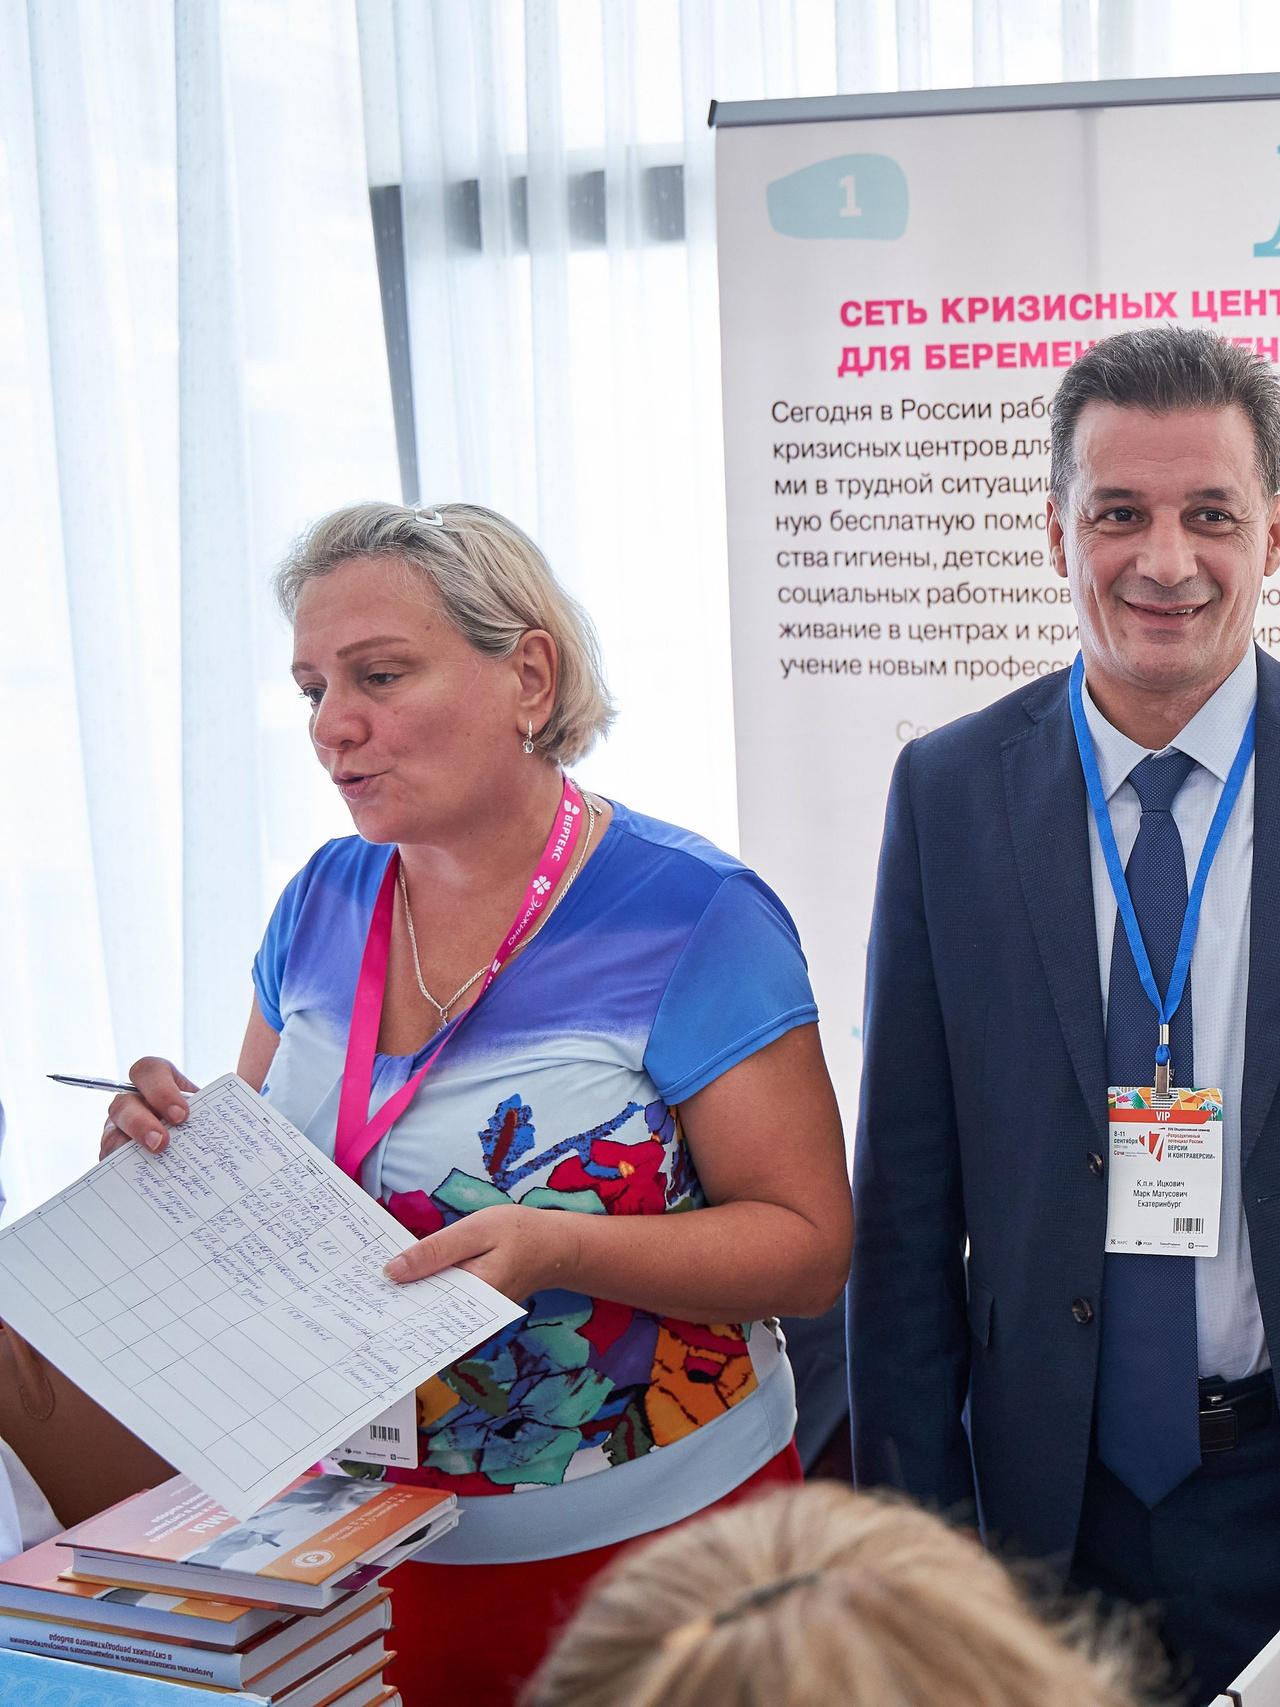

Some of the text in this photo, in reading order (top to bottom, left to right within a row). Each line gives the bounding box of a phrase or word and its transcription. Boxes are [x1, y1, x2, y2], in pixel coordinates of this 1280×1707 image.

[838, 175, 861, 216] 1
[840, 299, 927, 327] СЕТЬ
[941, 291, 1176, 324] КРИЗИСНЫХ
[838, 346, 909, 378] ДЛЯ
[926, 340, 1098, 370] БЕРЕМЕН
[772, 401, 872, 424] Сегодня
[881, 405, 892, 420] в
[901, 399, 992, 421] России
[774, 441, 899, 462] кризисных
[907, 439, 1007, 460] центров
[775, 478, 806, 494] ми
[817, 478, 827, 494] в
[836, 473, 932, 498] трудной
[776, 513, 821, 535] ную
[830, 510, 974, 535] бесплатную
[985, 513, 1047, 529] помо
[777, 550, 828, 567] ства
[834, 550, 937, 571] гигиены,
[943, 549, 1043, 571] детские
[778, 586, 920, 607] социальных
[927, 582, 1071, 608] работников
[779, 622, 880, 639] живание
[889, 623, 900, 639] в
[909, 623, 1008, 643] центрах
[1016, 623, 1029, 640] и
[780, 658, 861, 678] учение
[870, 657, 946, 675] новым
[552, 814, 573, 861] ВЕРТЕКС
[1156, 1112, 1170, 1121] VIP
[1133, 1190, 1187, 1198] Марк Матусович
[1157, 1180, 1184, 1188] Ицкович
[1138, 1201, 1182, 1209] Екатеринбург
[49, 1633, 74, 1645] выбора
[76, 1638, 131, 1654] репродуктивного
[133, 1647, 166, 1659] ситуациях
[178, 1665, 213, 1678] Алгоритмы
